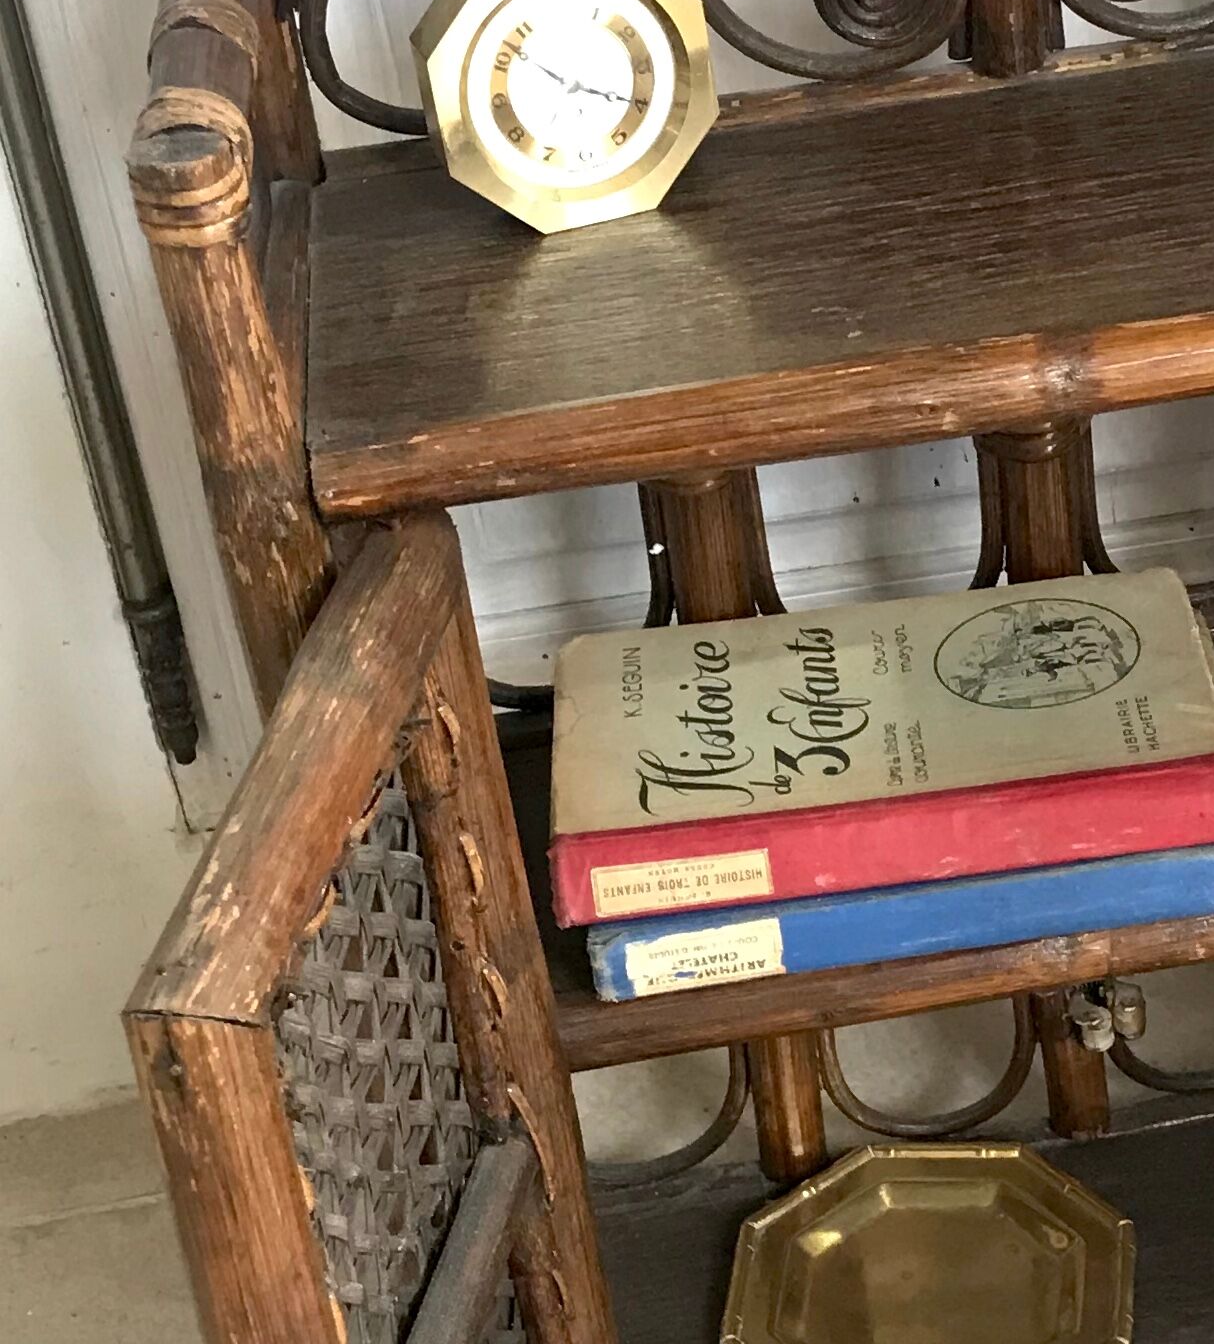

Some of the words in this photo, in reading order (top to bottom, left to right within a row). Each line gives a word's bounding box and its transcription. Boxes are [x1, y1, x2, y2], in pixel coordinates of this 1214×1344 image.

[515, 22, 533, 40] 11
[493, 51, 512, 74] 10
[491, 91, 508, 109] 9
[633, 97, 650, 115] 4
[507, 126, 525, 144] 8
[610, 130, 627, 147] 5
[542, 146, 557, 162] 7
[766, 627, 872, 743] Enfants
[635, 639, 755, 816] Histoire
[1115, 698, 1140, 754] LIBRAIRIE
[1135, 695, 1160, 752] HACHETTE
[774, 745, 851, 776] 3
[749, 774, 792, 795] de
[657, 876, 691, 891] TROIS
[695, 874, 710, 888] DE
[715, 868, 763, 885] HISTOIRE
[603, 881, 652, 899] ENFANTS
